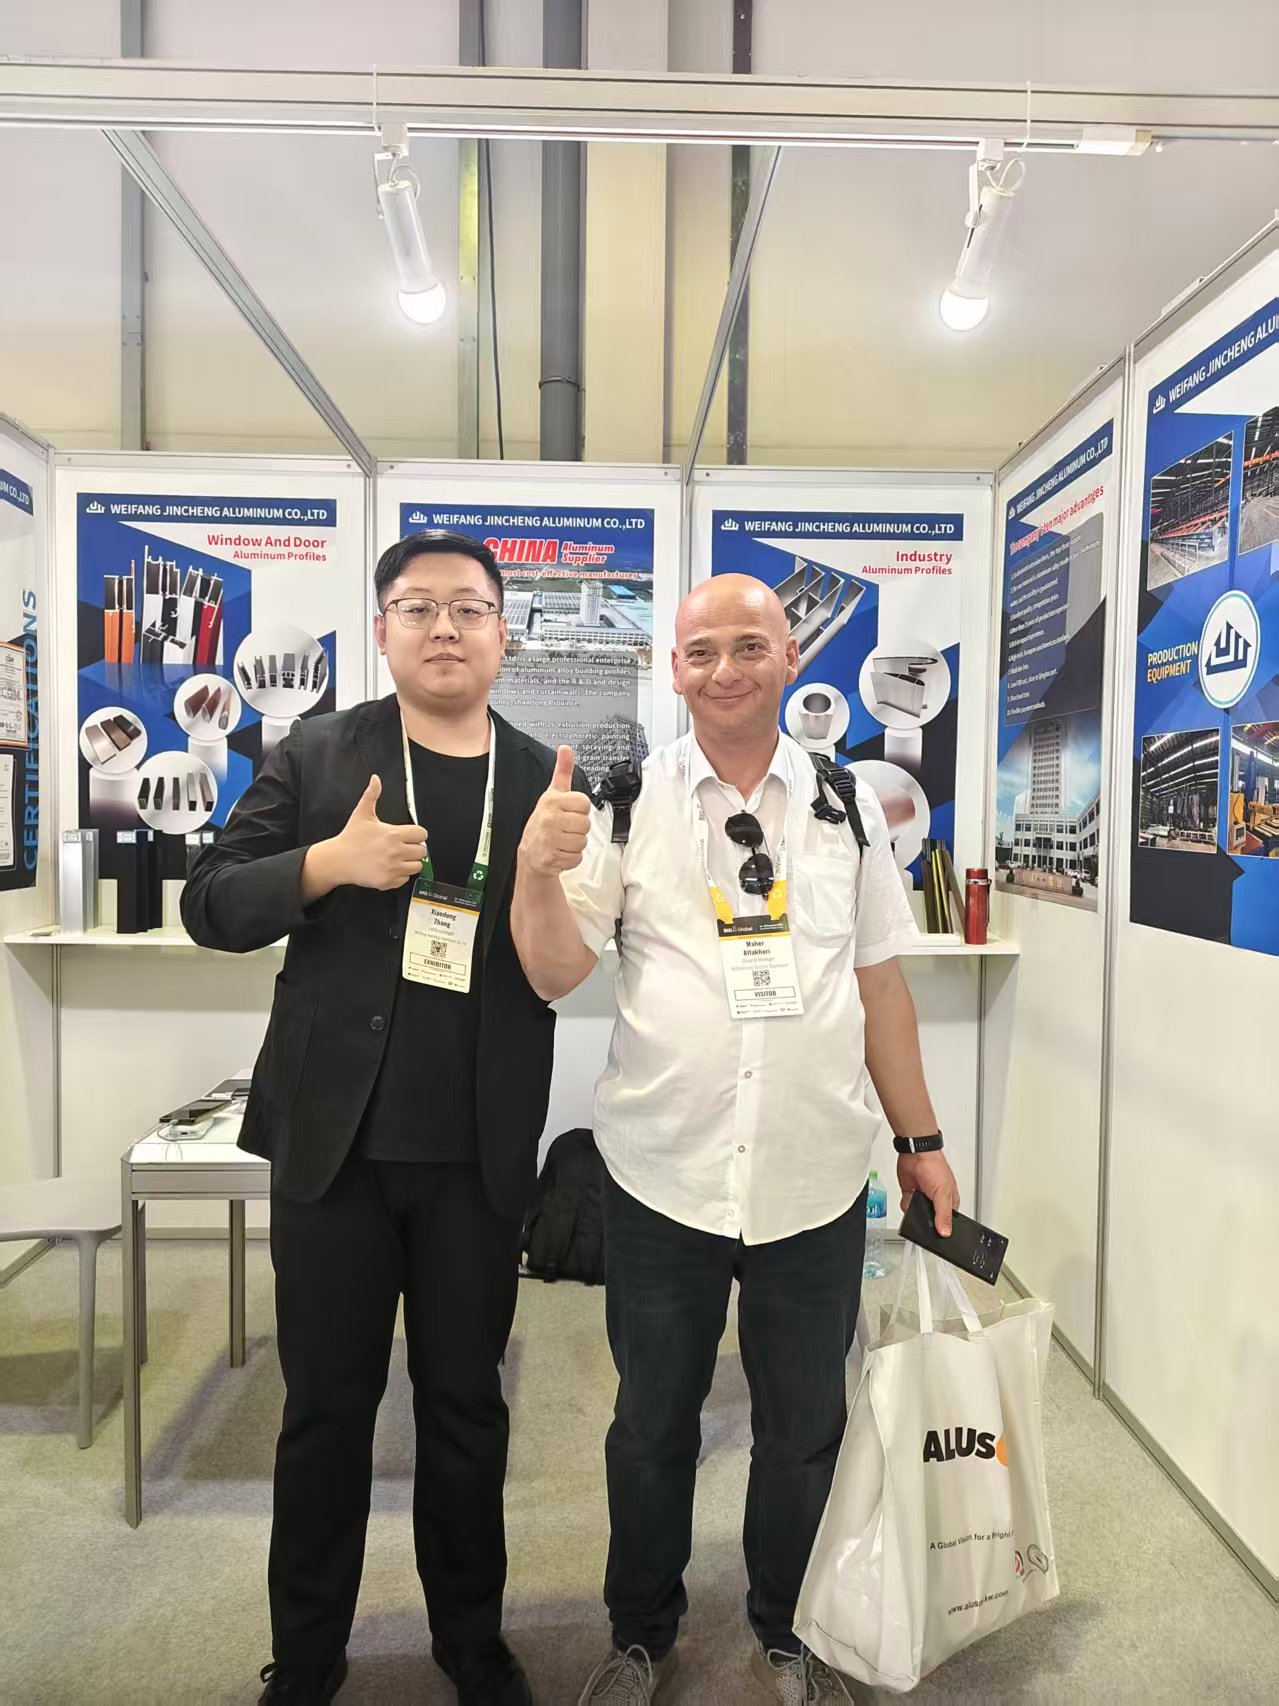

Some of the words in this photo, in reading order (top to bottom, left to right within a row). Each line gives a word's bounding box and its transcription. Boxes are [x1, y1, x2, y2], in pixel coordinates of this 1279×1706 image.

[1168, 366, 1206, 403] WEIFANG
[1207, 332, 1254, 377] JINCHENG
[110, 503, 161, 515] WEIFANG
[163, 505, 220, 517] JINCHENG
[222, 507, 283, 519] ALUMINUM
[285, 508, 327, 521] CO.,LTD
[432, 513, 482, 525] WEIFANG
[484, 515, 540, 527] JINCHENG
[542, 516, 602, 528] ALUMINUM
[604, 518, 645, 531] CO.,LTD
[744, 521, 793, 532] WEIFANG
[795, 522, 850, 533] JINCHENG
[852, 522, 911, 534] ALUMINUM
[913, 523, 955, 536] CO.,LTD
[207, 534, 262, 547] Window
[265, 535, 291, 548] And
[294, 536, 327, 549] Door
[561, 541, 615, 554] Aluminum
[233, 550, 286, 560] Aluminum
[287, 551, 327, 562] Profiles
[562, 552, 607, 566] Supplier
[896, 549, 953, 565] Industry
[500, 569, 520, 578] most
[579, 569, 637, 580] manufacturer
[862, 565, 913, 575] Aluminum
[915, 565, 953, 575] Profiles
[1148, 640, 1199, 667] PRODUCTION
[533, 655, 549, 664] large
[551, 656, 594, 664] professional
[595, 657, 632, 666] enterprise
[557, 667, 573, 675] alloy
[575, 667, 603, 676] building
[604, 668, 631, 676] profiles
[1147, 659, 1192, 684] EQUIPMENT
[608, 679, 631, 688] design
[600, 690, 631, 698] company
[23, 588, 40, 870] CERTIFICATIONS
[530, 720, 545, 728] with
[558, 721, 590, 729] extrusion
[592, 722, 630, 731] production
[601, 733, 630, 742] painting
[582, 743, 613, 752] spraying
[582, 754, 600, 762] grain
[602, 754, 630, 762] transfer
[434, 918, 451, 929] Zhang
[424, 958, 452, 970] EXHIBITOR
[755, 990, 777, 998] VISITOR
[930, 1542, 936, 1550] A
[937, 1540, 957, 1550] Global
[974, 1533, 984, 1541] for
